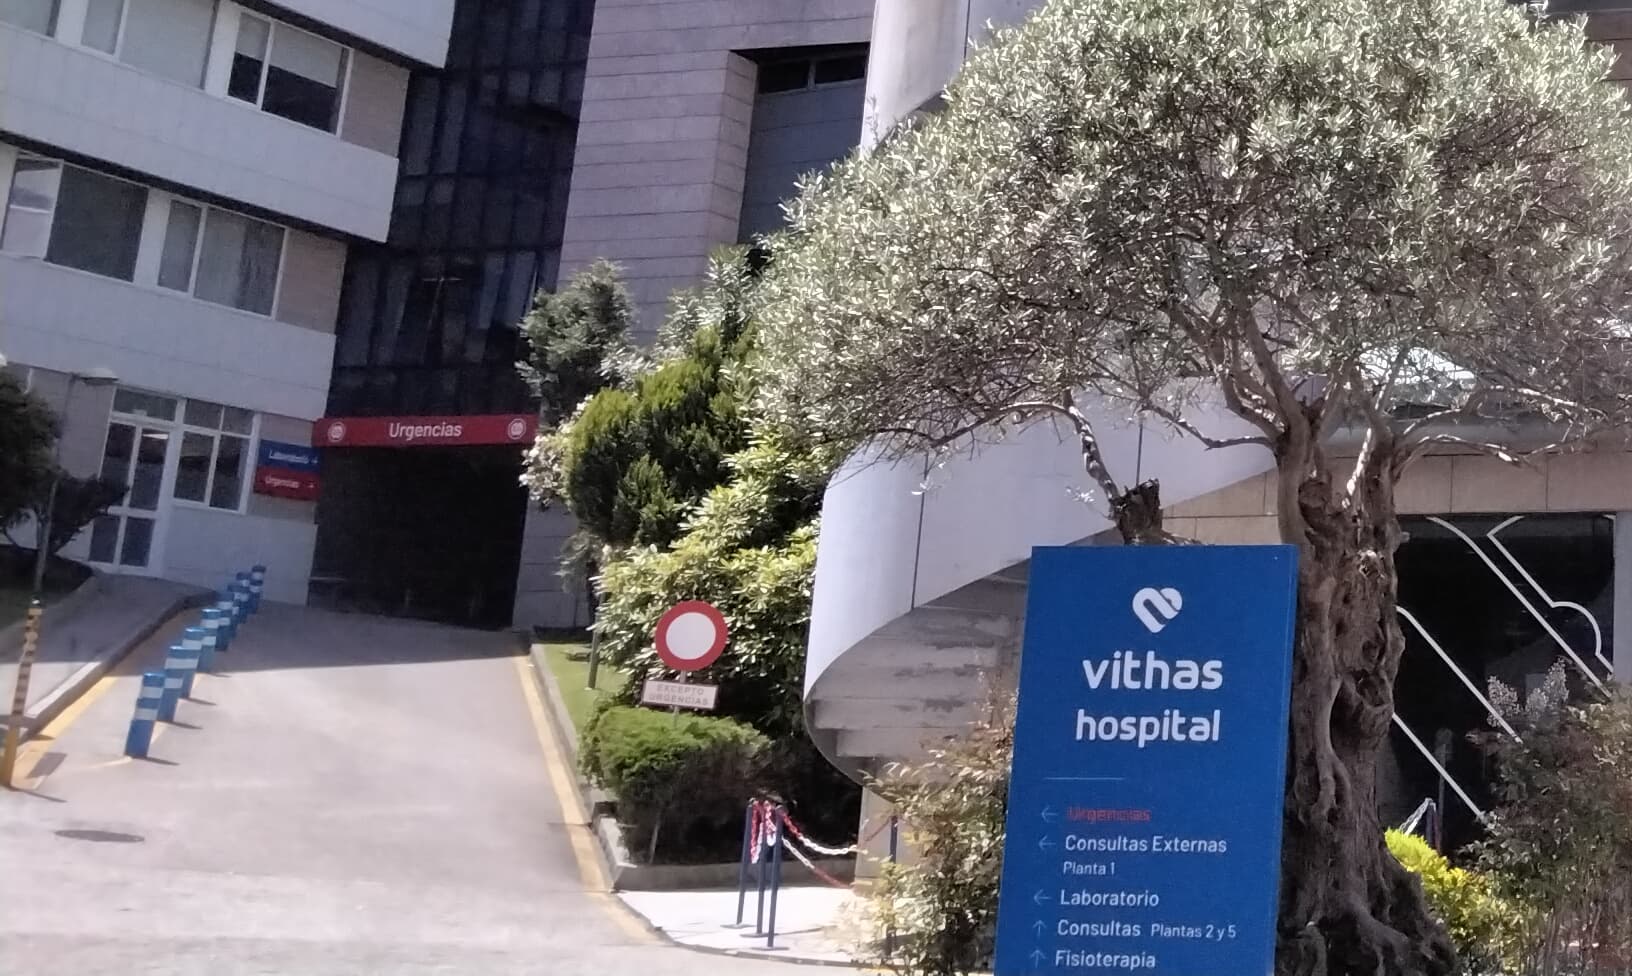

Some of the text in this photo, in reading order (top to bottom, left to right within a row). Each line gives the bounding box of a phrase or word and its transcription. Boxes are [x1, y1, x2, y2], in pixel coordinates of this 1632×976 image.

[389, 421, 462, 441] Urgencias
[1082, 650, 1223, 689] vithas
[657, 684, 704, 695] EXCEPTO
[1075, 709, 1220, 748] hospital
[1066, 807, 1151, 824] Urgencias
[1065, 834, 1227, 854] Consultas Externas
[1063, 861, 1116, 875] Planta 1
[1060, 889, 1160, 908] Laboratorio
[1057, 919, 1236, 943] Consultas Plantas 2 y 5
[1055, 950, 1156, 971] Fisioterapia
